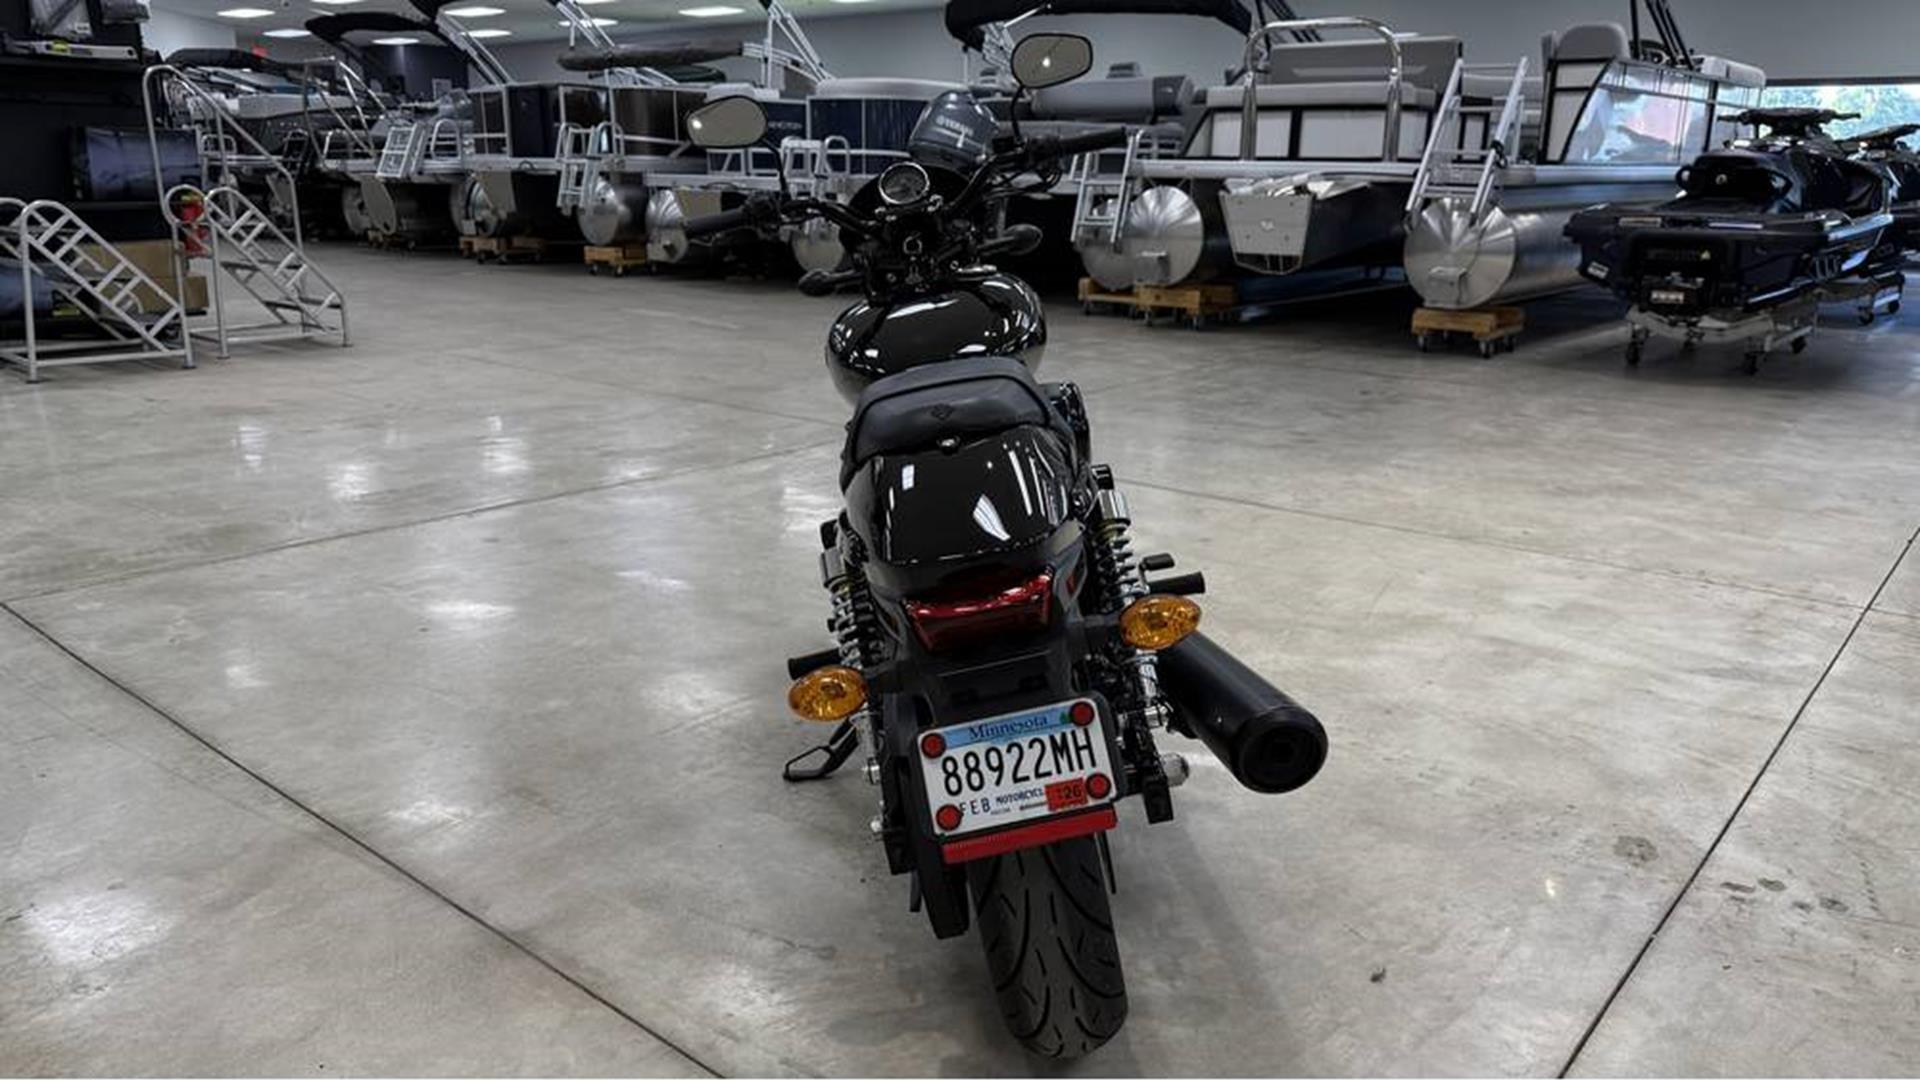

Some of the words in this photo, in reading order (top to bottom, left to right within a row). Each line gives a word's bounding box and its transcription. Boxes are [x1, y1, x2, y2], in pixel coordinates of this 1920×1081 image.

[968, 714, 1048, 741] Minnesota
[941, 727, 1097, 797] 88922MH
[959, 797, 991, 817] FEB
[996, 788, 1045, 805] MOTORCYCL
